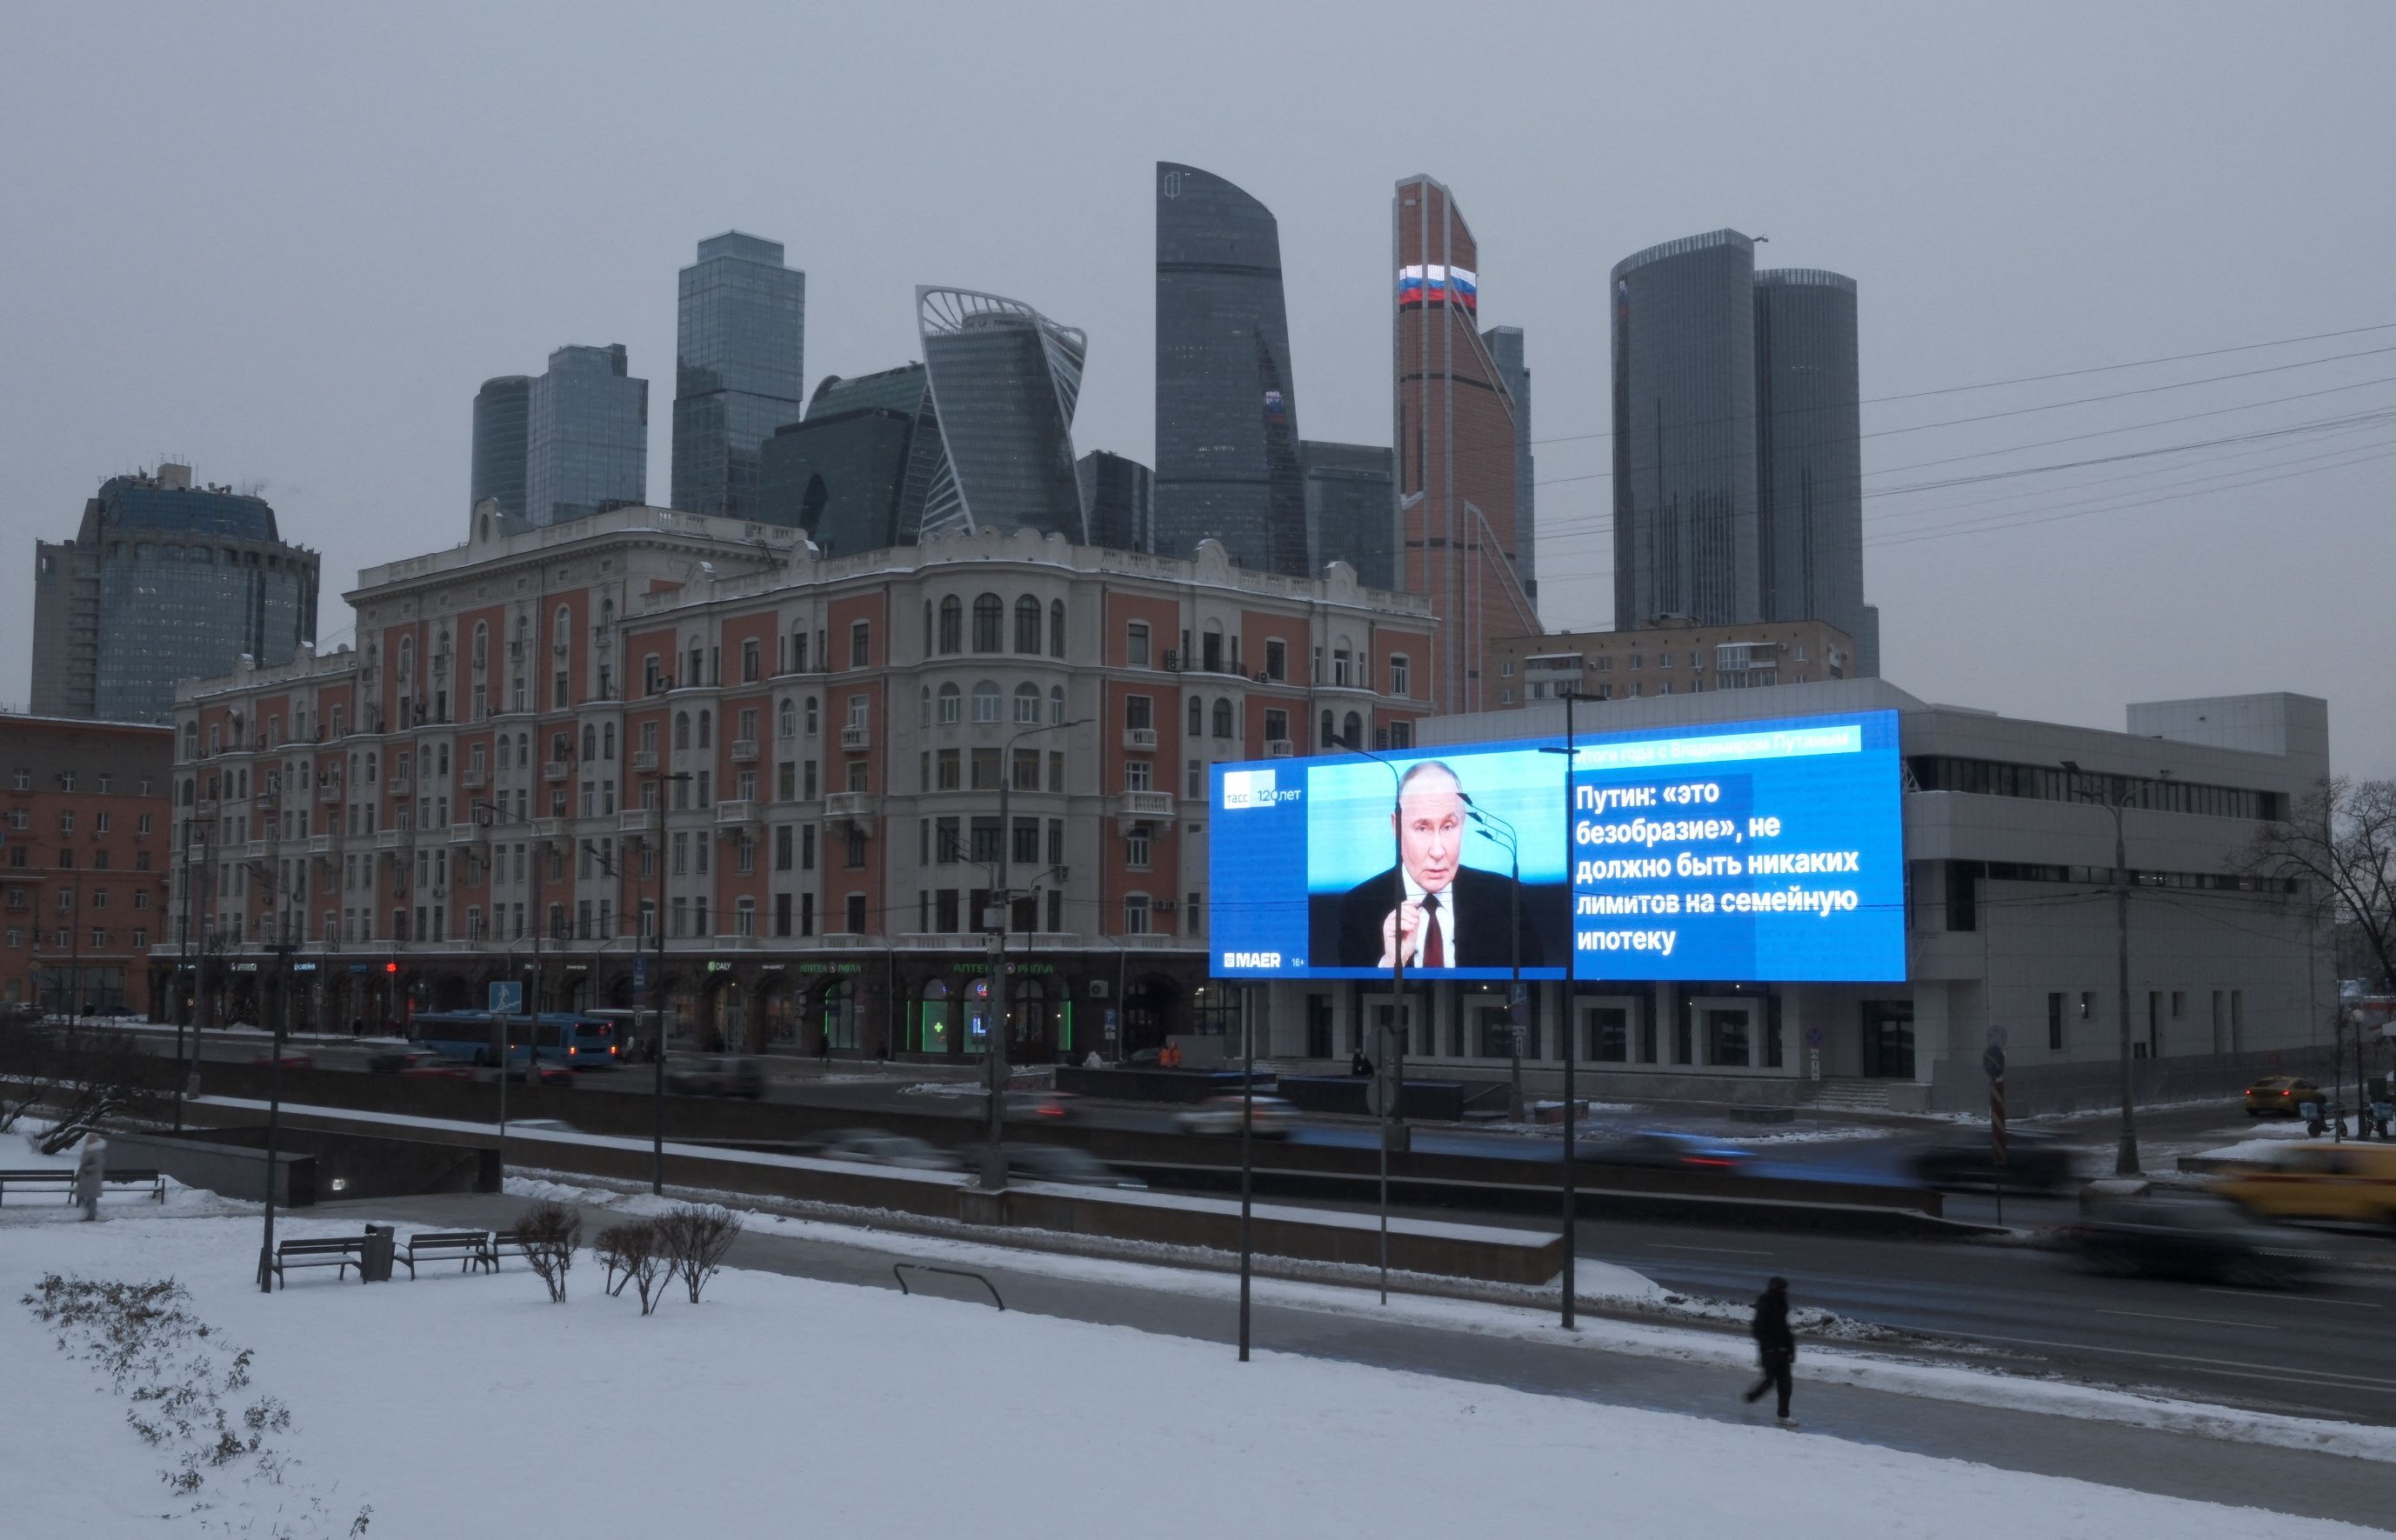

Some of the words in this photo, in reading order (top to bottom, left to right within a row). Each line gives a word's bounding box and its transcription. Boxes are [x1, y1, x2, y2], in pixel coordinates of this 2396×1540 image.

[1577, 785, 1657, 814] Путин:
[1663, 783, 1719, 804] «это
[1576, 817, 1742, 848] безобразие»,
[1749, 817, 1780, 837] не
[1576, 857, 1672, 884] должно
[1677, 852, 1742, 877] быть
[1748, 851, 1859, 875] никаких
[1577, 894, 1680, 915] лимитов
[1685, 894, 1715, 913] на
[1720, 885, 1859, 917] семейную
[1578, 930, 1677, 956] ипотеку
[716, 962, 731, 970] DAILY
[953, 963, 989, 973] АПТЕ
[1236, 953, 1280, 968] MAER
